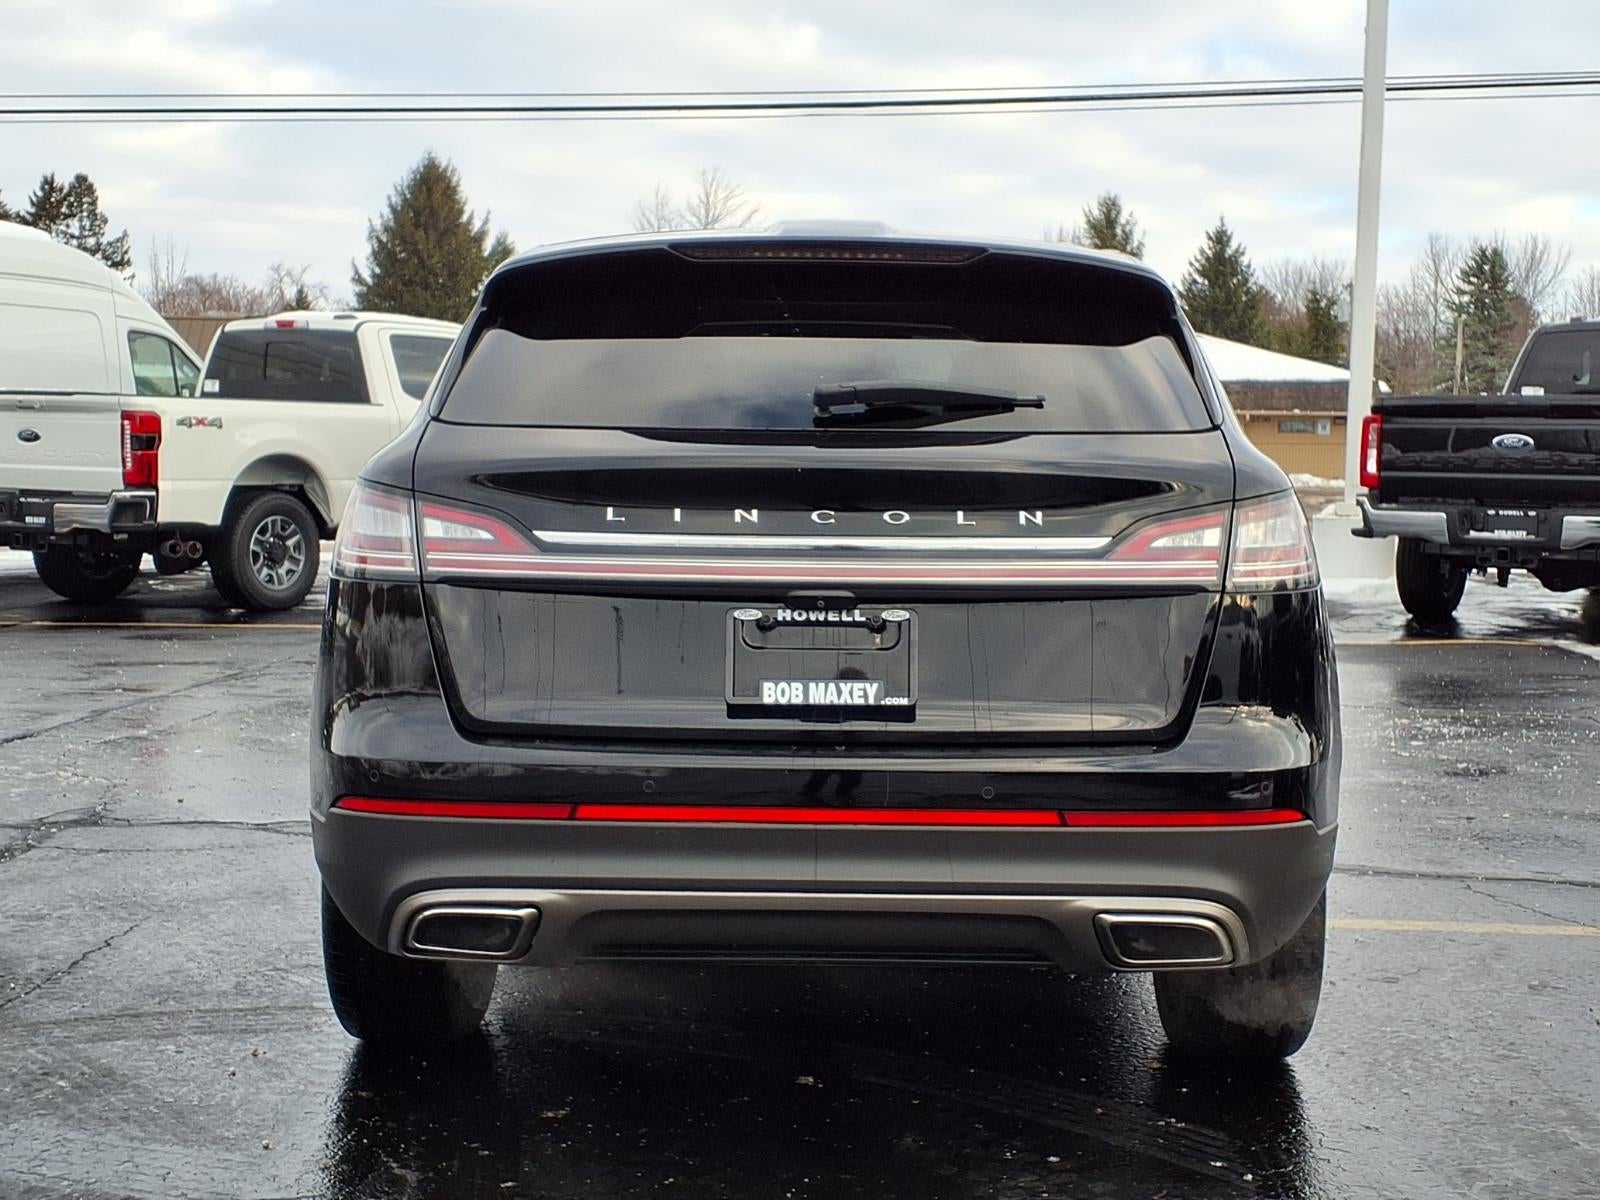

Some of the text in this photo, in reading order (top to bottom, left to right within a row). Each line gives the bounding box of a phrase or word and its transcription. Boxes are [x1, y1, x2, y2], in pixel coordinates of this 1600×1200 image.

[605, 506, 1044, 527] LINCOLN
[776, 608, 867, 622] HOWELL
[762, 681, 804, 704] BOB
[808, 682, 879, 705] MAXEY
